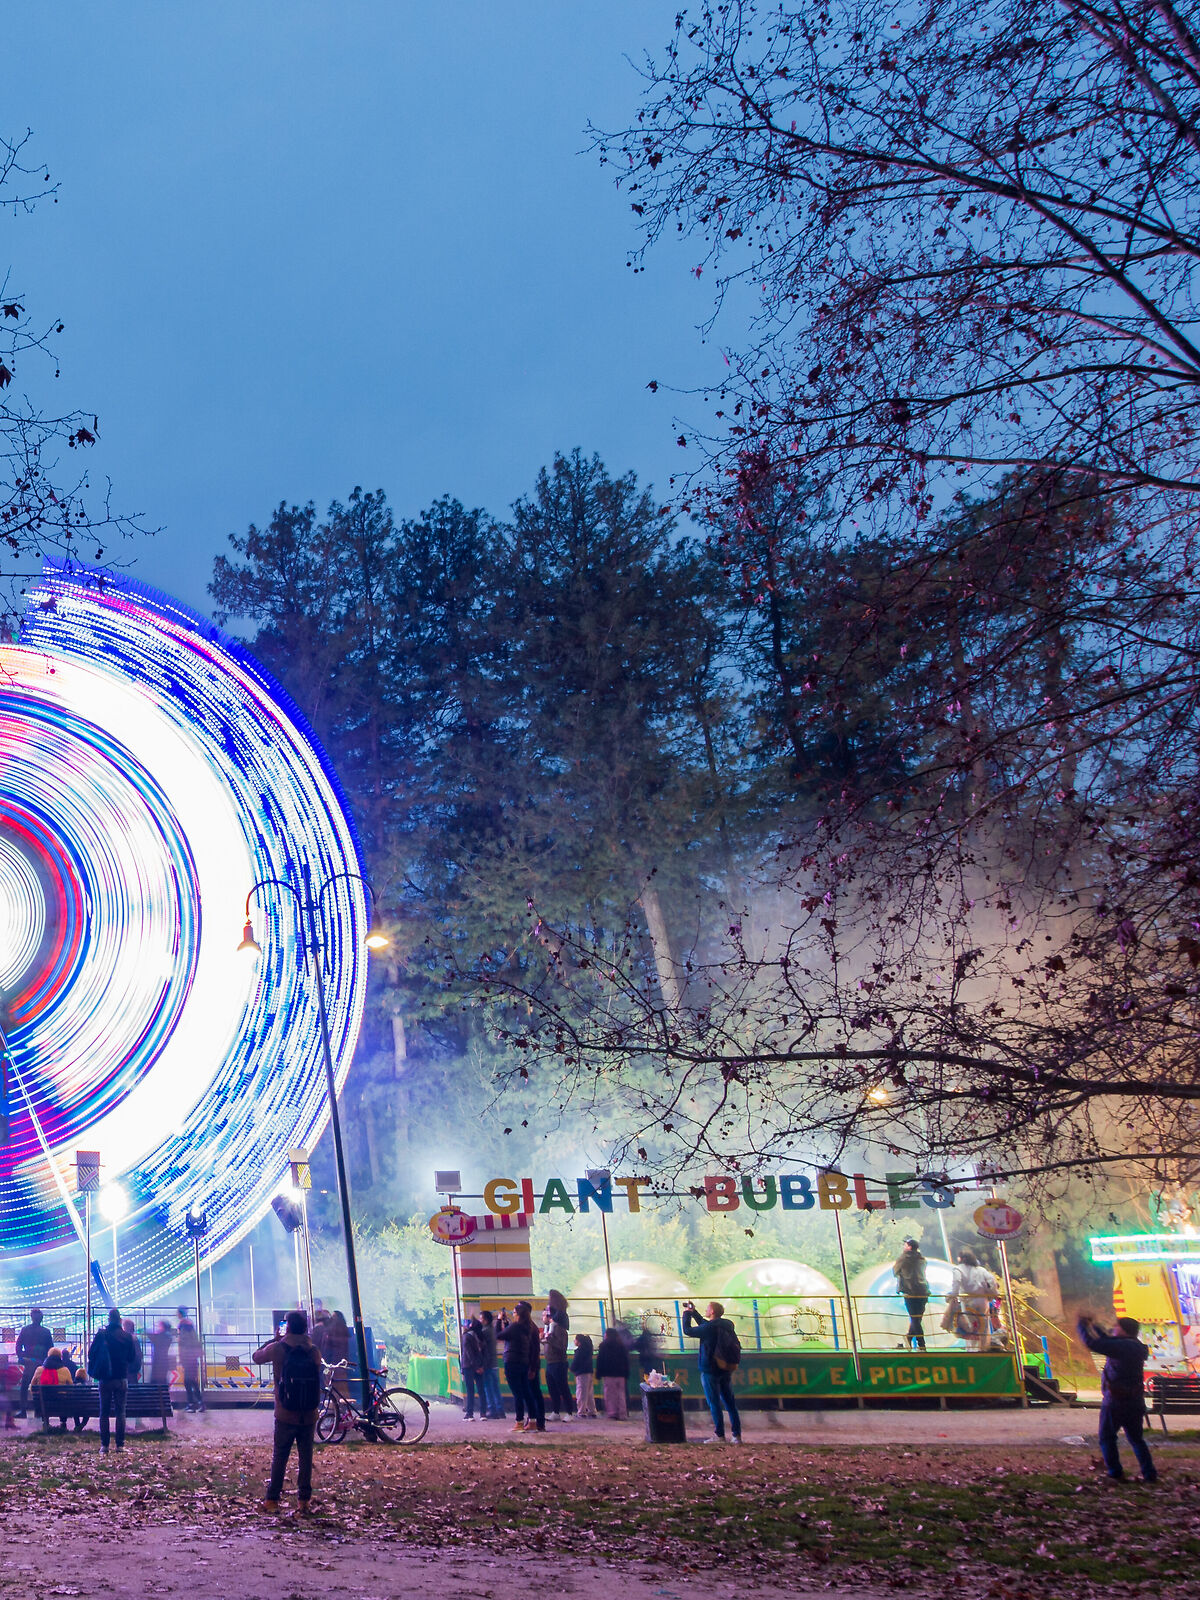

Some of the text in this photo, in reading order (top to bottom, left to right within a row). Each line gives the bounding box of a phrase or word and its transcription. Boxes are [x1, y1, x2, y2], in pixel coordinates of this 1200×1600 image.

[484, 1172, 955, 1214] GIANT BUBBLES
[731, 1366, 976, 1386] RANDI E PICCOLI
